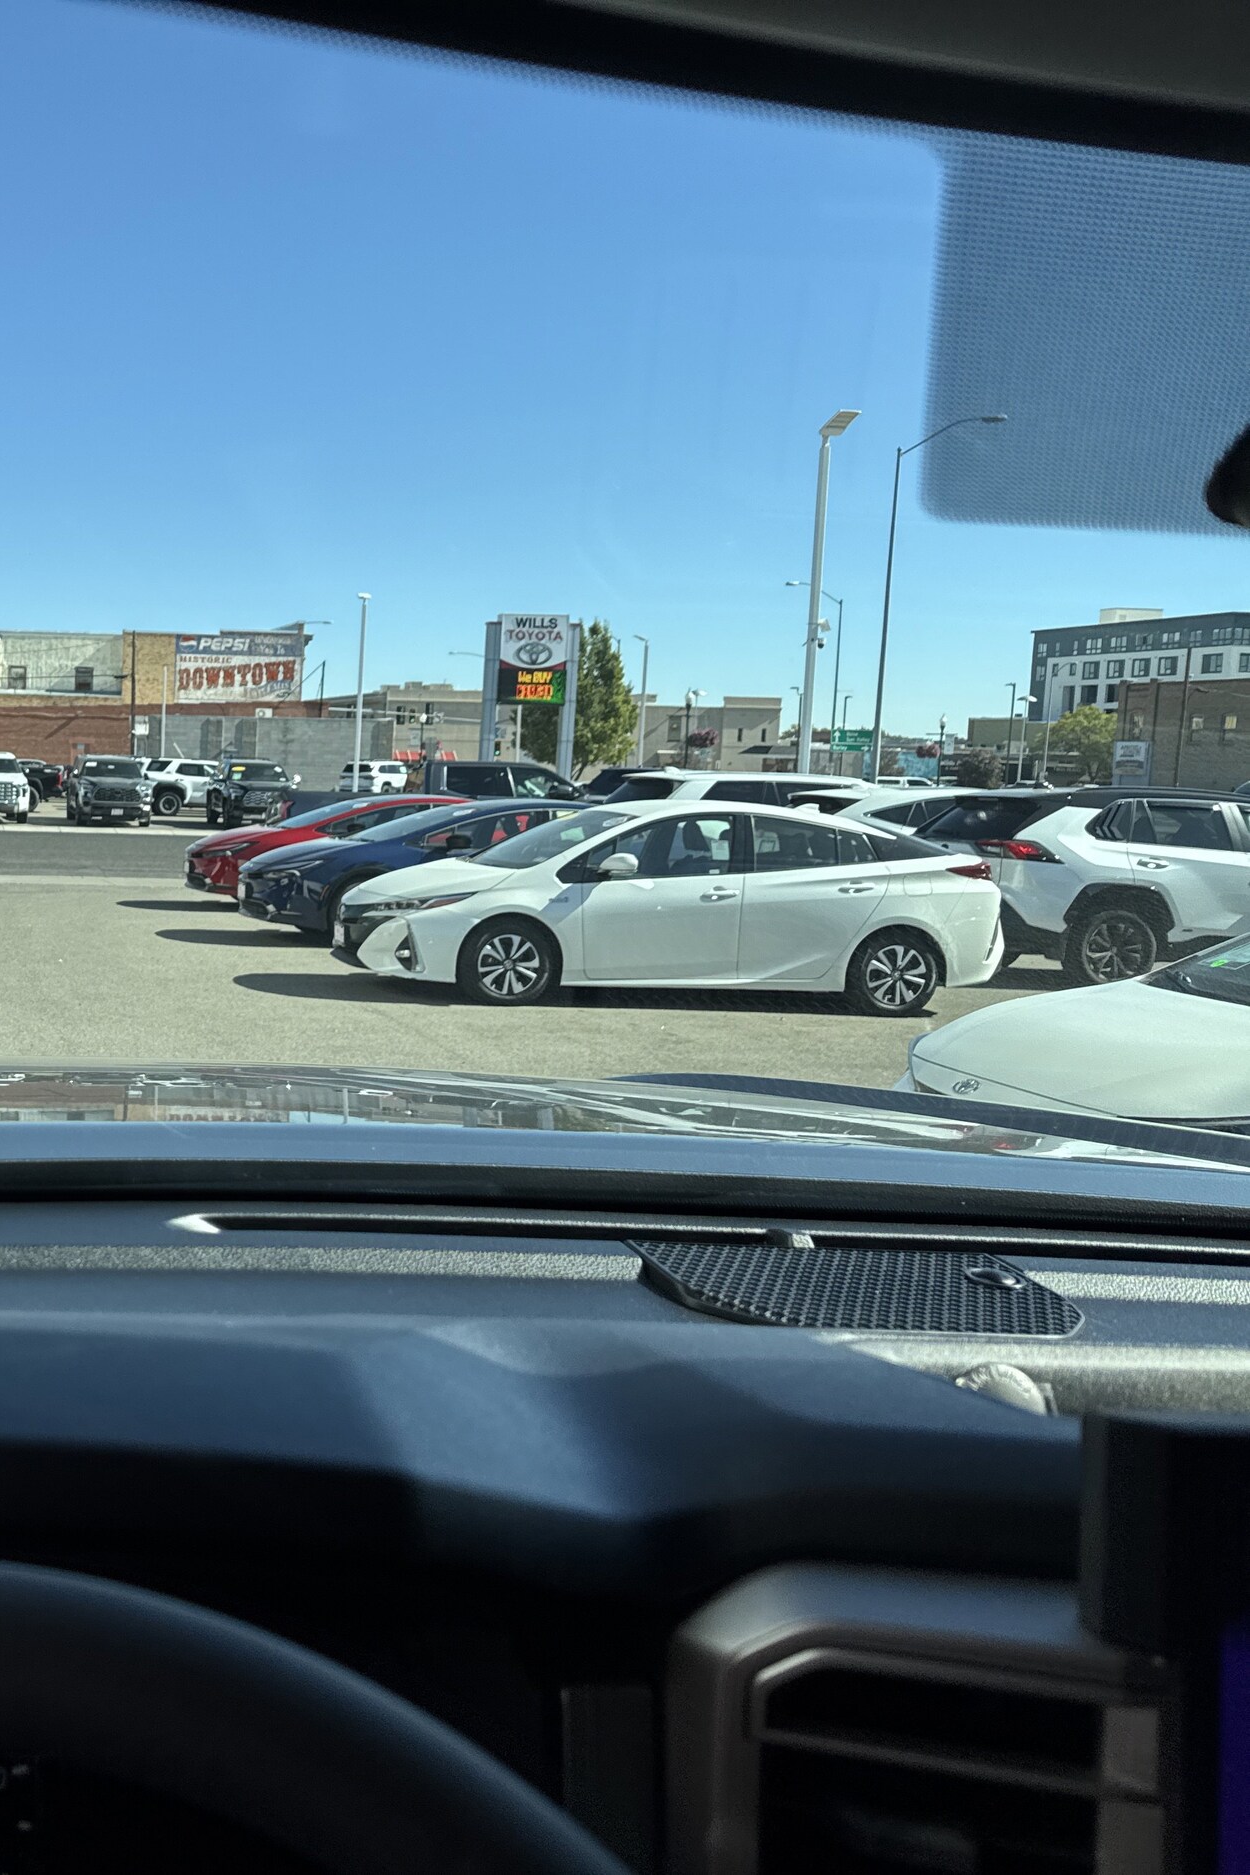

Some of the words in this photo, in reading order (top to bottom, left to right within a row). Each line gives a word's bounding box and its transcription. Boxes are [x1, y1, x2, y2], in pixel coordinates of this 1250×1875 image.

[515, 617, 558, 629] WILLS
[507, 629, 563, 641] TOYOTA
[198, 637, 250, 652] PEPSI
[179, 655, 233, 663] HISTORIC
[178, 659, 296, 691] DOWNTOWN
[532, 671, 552, 683] BUY
